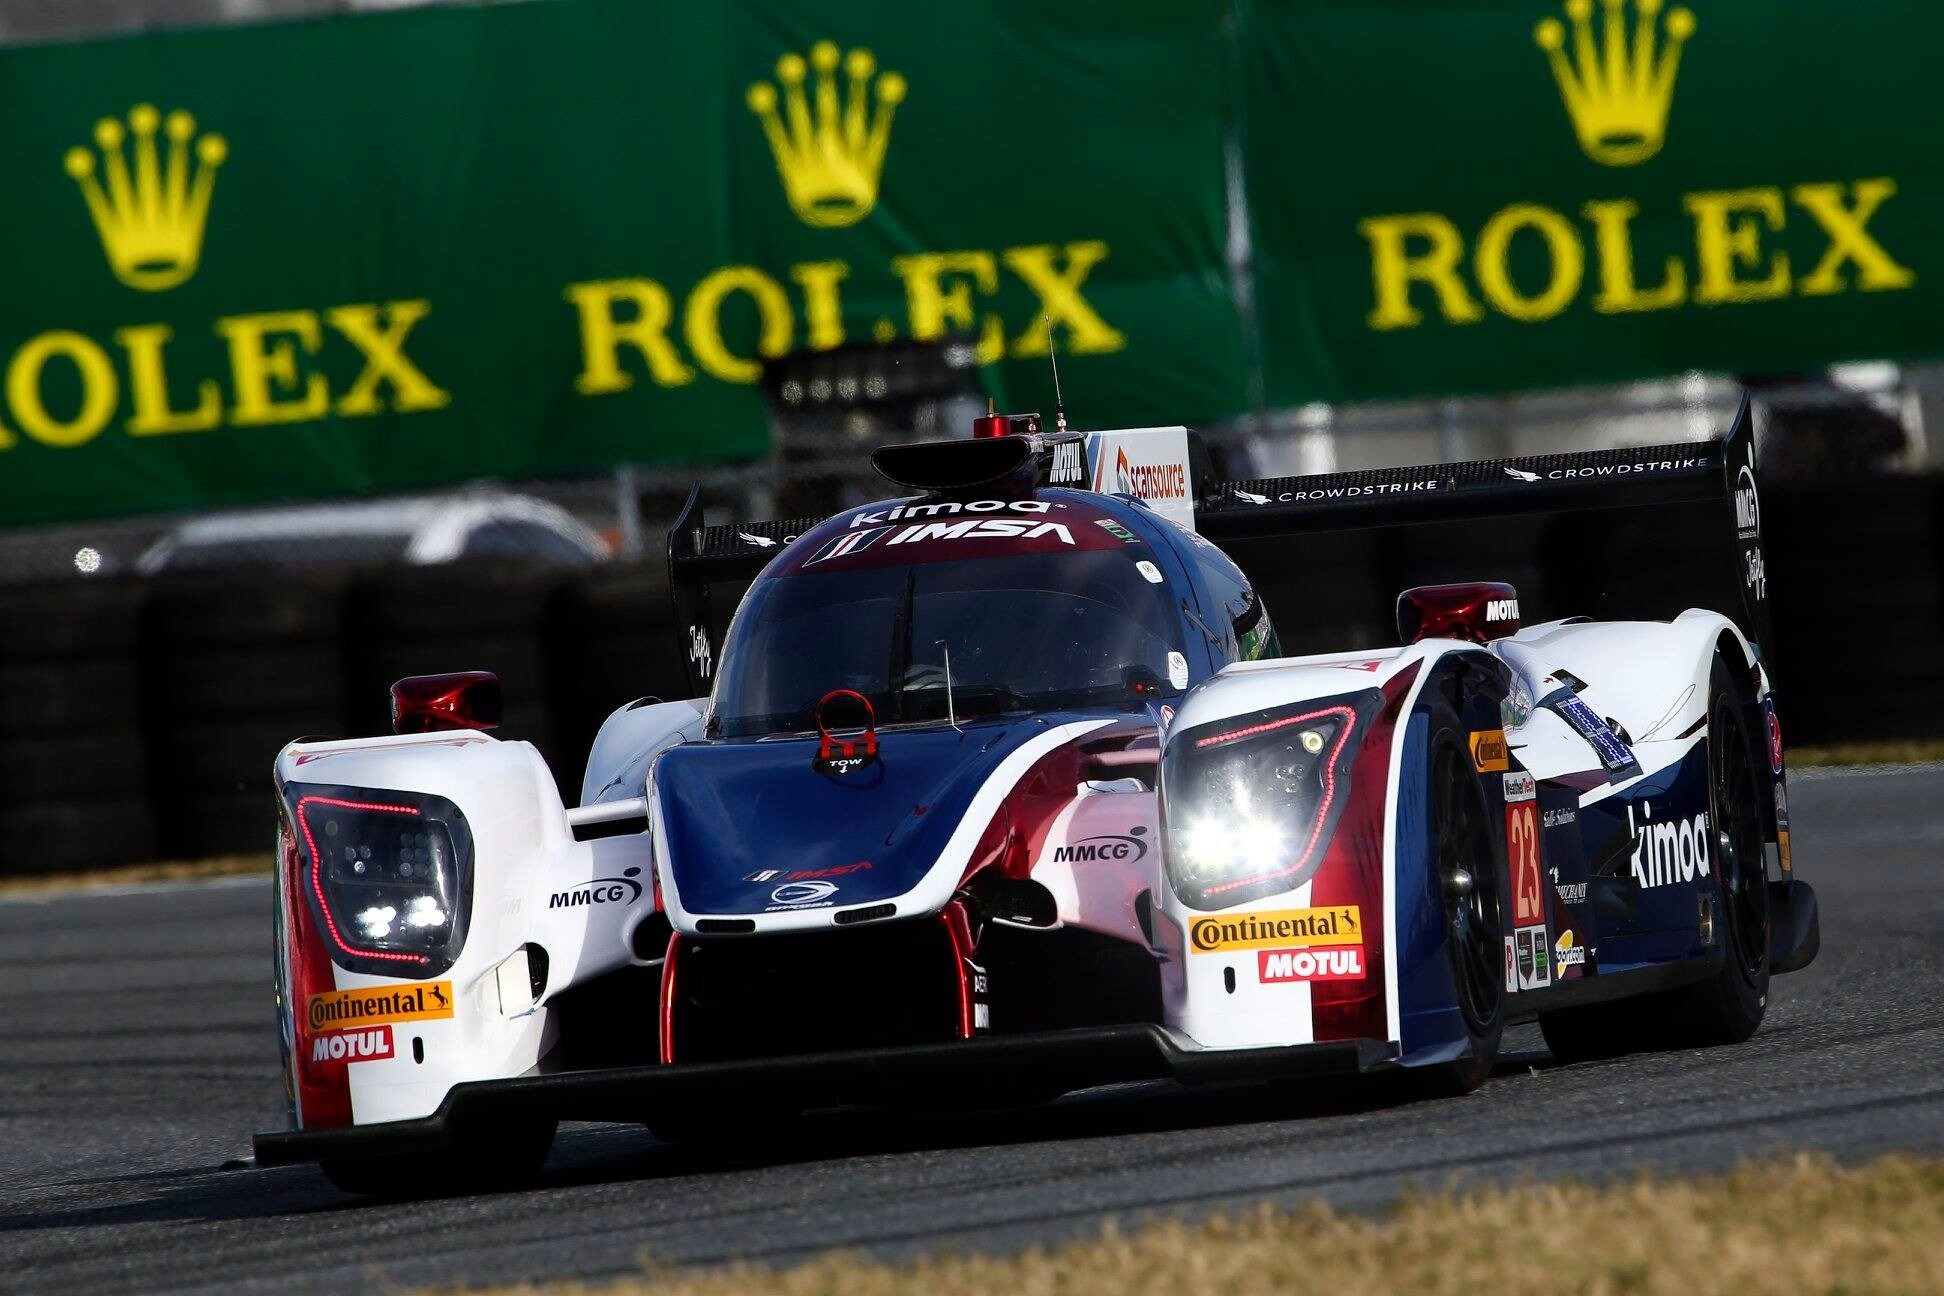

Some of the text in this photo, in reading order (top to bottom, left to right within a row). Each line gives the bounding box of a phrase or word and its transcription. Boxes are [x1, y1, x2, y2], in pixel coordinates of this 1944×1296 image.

[1358, 178, 1914, 330] ROLEX
[565, 240, 1126, 396] ROLEX
[0, 300, 450, 450] OLEX
[1049, 442, 1082, 483] MOTUL
[1548, 457, 1708, 480] CROWDSTRIKE
[1130, 463, 1185, 499] scansource
[1278, 480, 1437, 502] CROWDSTRIKE
[849, 500, 1052, 528] kimoa
[886, 520, 1076, 545] IMSA
[829, 758, 862, 767] TOW
[1053, 843, 1130, 863] MMCG
[1627, 801, 1710, 888] kimoa
[1511, 807, 1540, 918] 23
[549, 885, 624, 909] MMCG
[1191, 911, 1338, 951] Continental
[1264, 953, 1362, 979] MOTUL
[308, 988, 425, 1028] Continental
[312, 1030, 390, 1062] MOTUL
